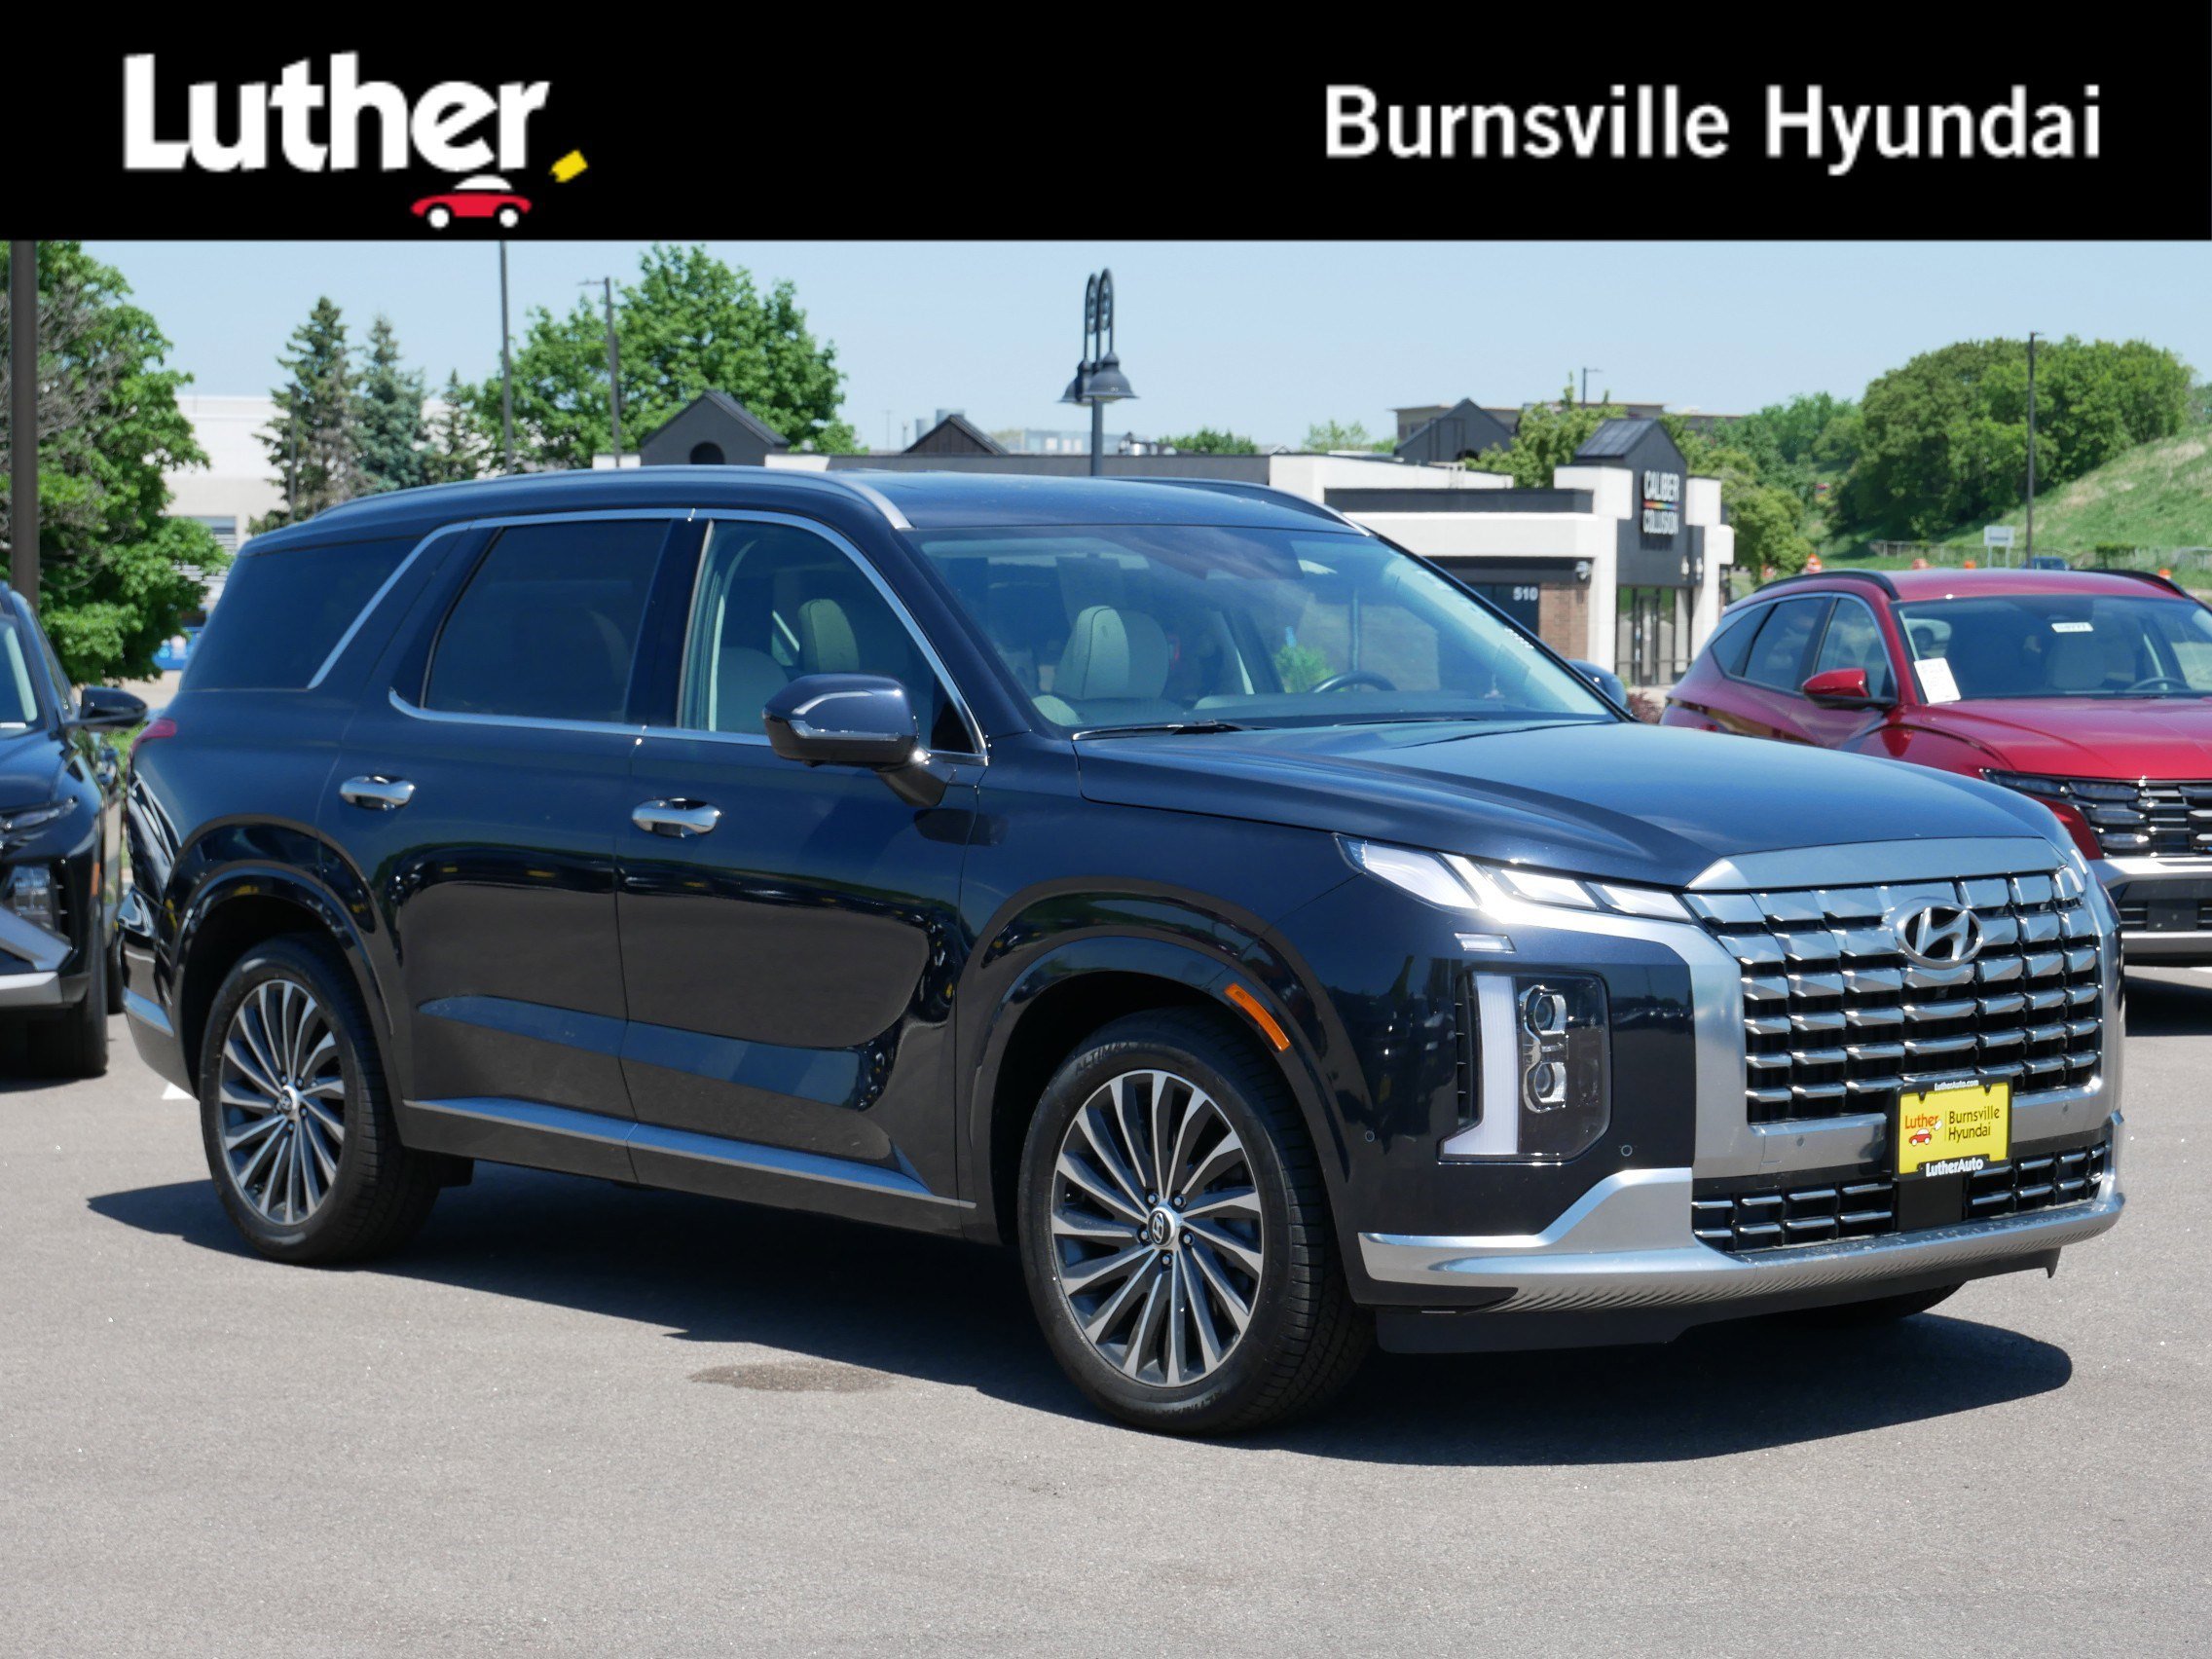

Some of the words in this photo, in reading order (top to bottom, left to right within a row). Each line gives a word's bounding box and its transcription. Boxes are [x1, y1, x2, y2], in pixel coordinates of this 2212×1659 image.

[1643, 470, 1680, 501] CALIBER
[1642, 508, 1679, 535] COLLISION
[1934, 1079, 1980, 1091] LutherAuto.com
[1904, 1113, 1939, 1130] Luther
[1948, 1105, 2000, 1125] Burnsville
[1948, 1122, 1992, 1143] Hyundai
[1925, 1157, 1984, 1178] LutherAuto
